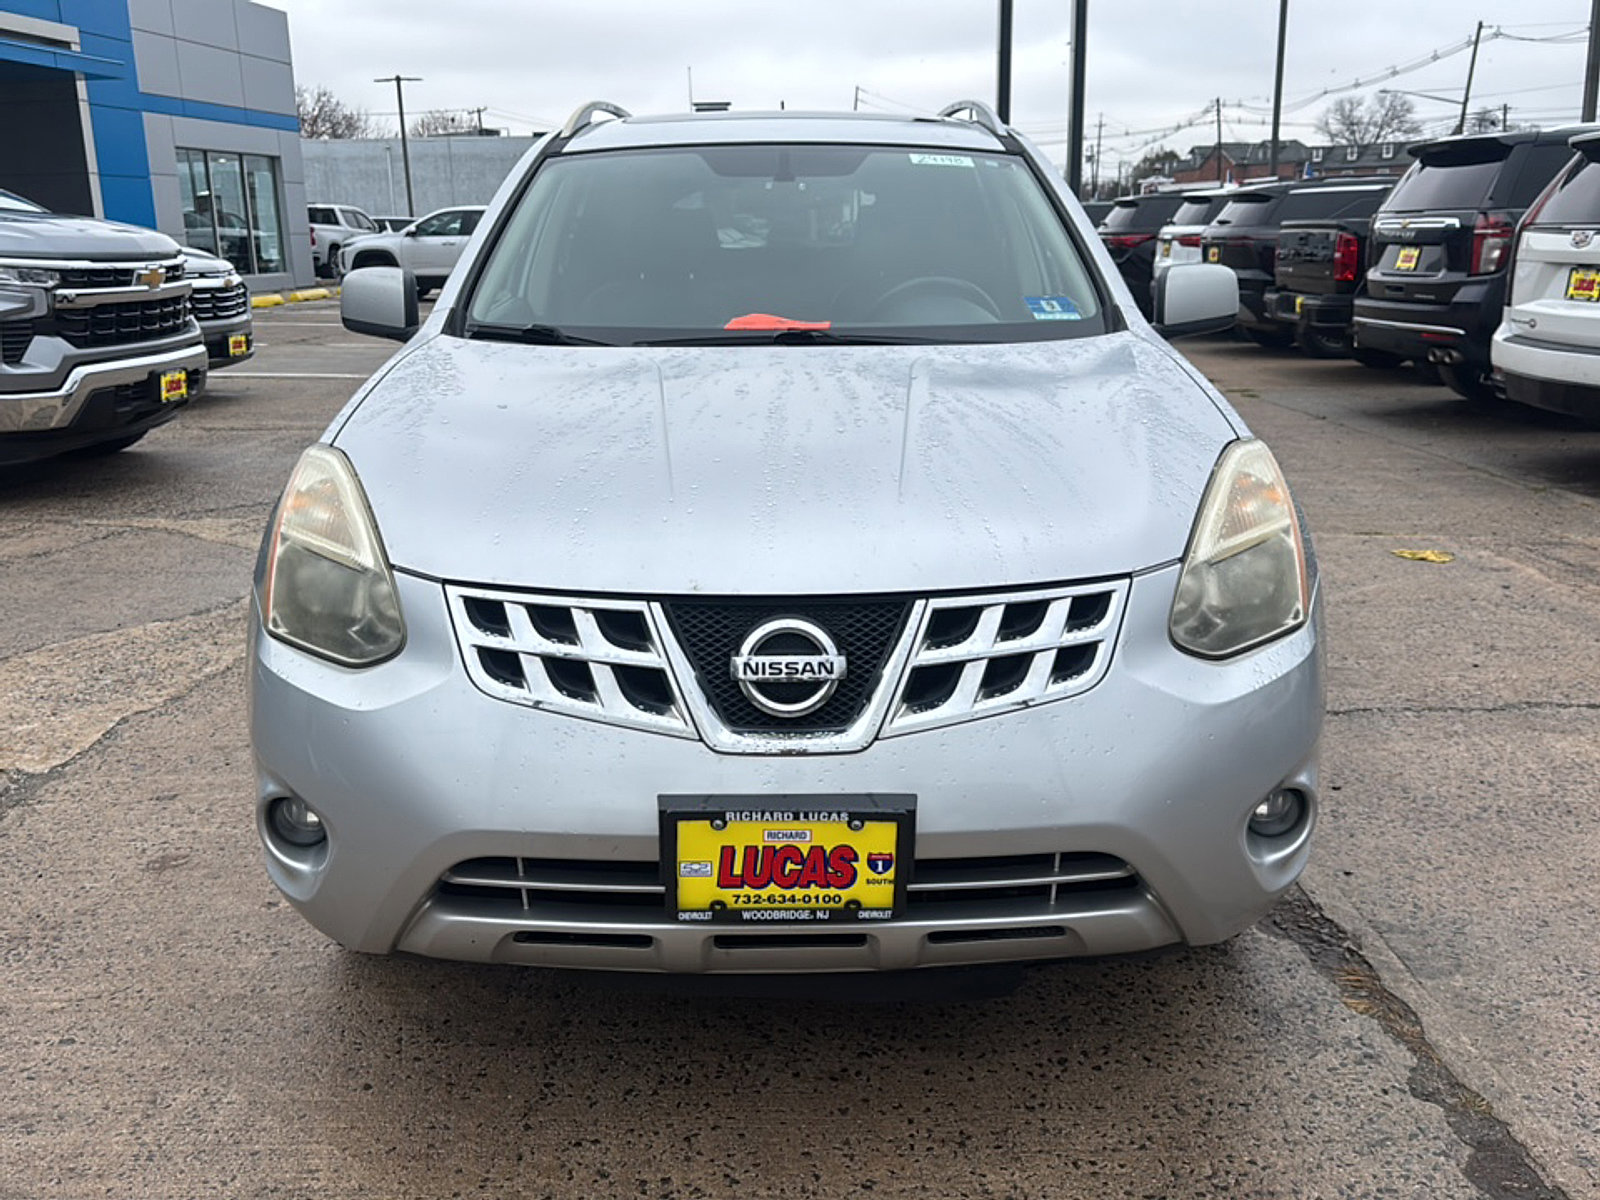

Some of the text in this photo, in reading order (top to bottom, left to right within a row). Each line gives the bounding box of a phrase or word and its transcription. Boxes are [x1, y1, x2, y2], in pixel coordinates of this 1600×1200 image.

[743, 661, 834, 676] NISSAN
[725, 811, 849, 822] RICHARD LUCAS
[766, 831, 807, 840] RICHARD
[717, 844, 860, 889] LUCAS
[875, 860, 884, 873] 1
[732, 893, 842, 905] 732-634-0100
[816, 910, 830, 919] NJ
